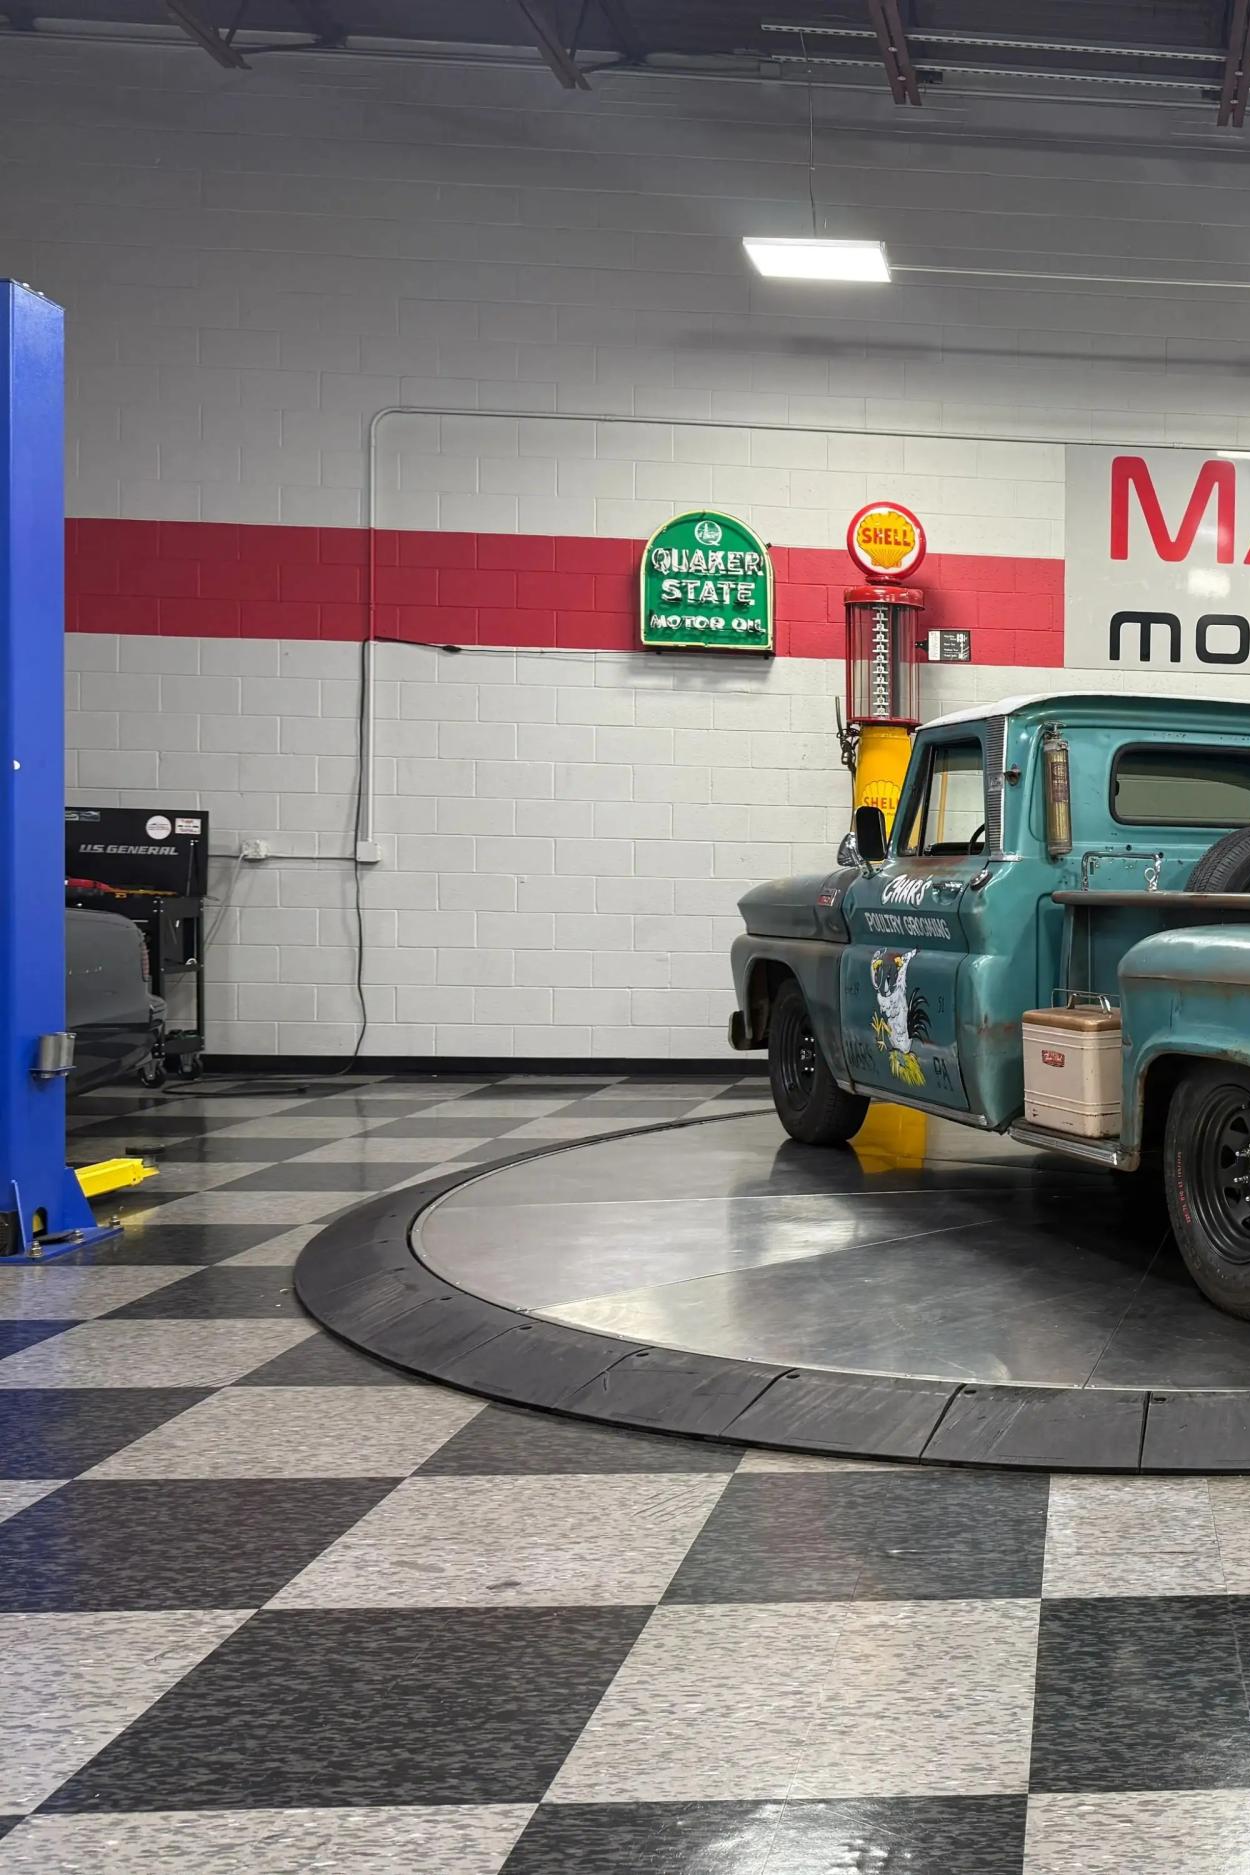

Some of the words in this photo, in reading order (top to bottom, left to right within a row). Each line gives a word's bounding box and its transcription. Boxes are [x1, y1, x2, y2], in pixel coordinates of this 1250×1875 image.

[861, 527, 911, 546] SHELL
[651, 547, 764, 575] QUAKER
[661, 578, 755, 605] STATE
[650, 614, 726, 631] MOTOR
[731, 617, 766, 633] OIL
[864, 796, 900, 809] SHEL
[105, 845, 179, 856] GENERAL
[864, 912, 904, 935] POULTRY
[903, 916, 951, 940] GROOMING
